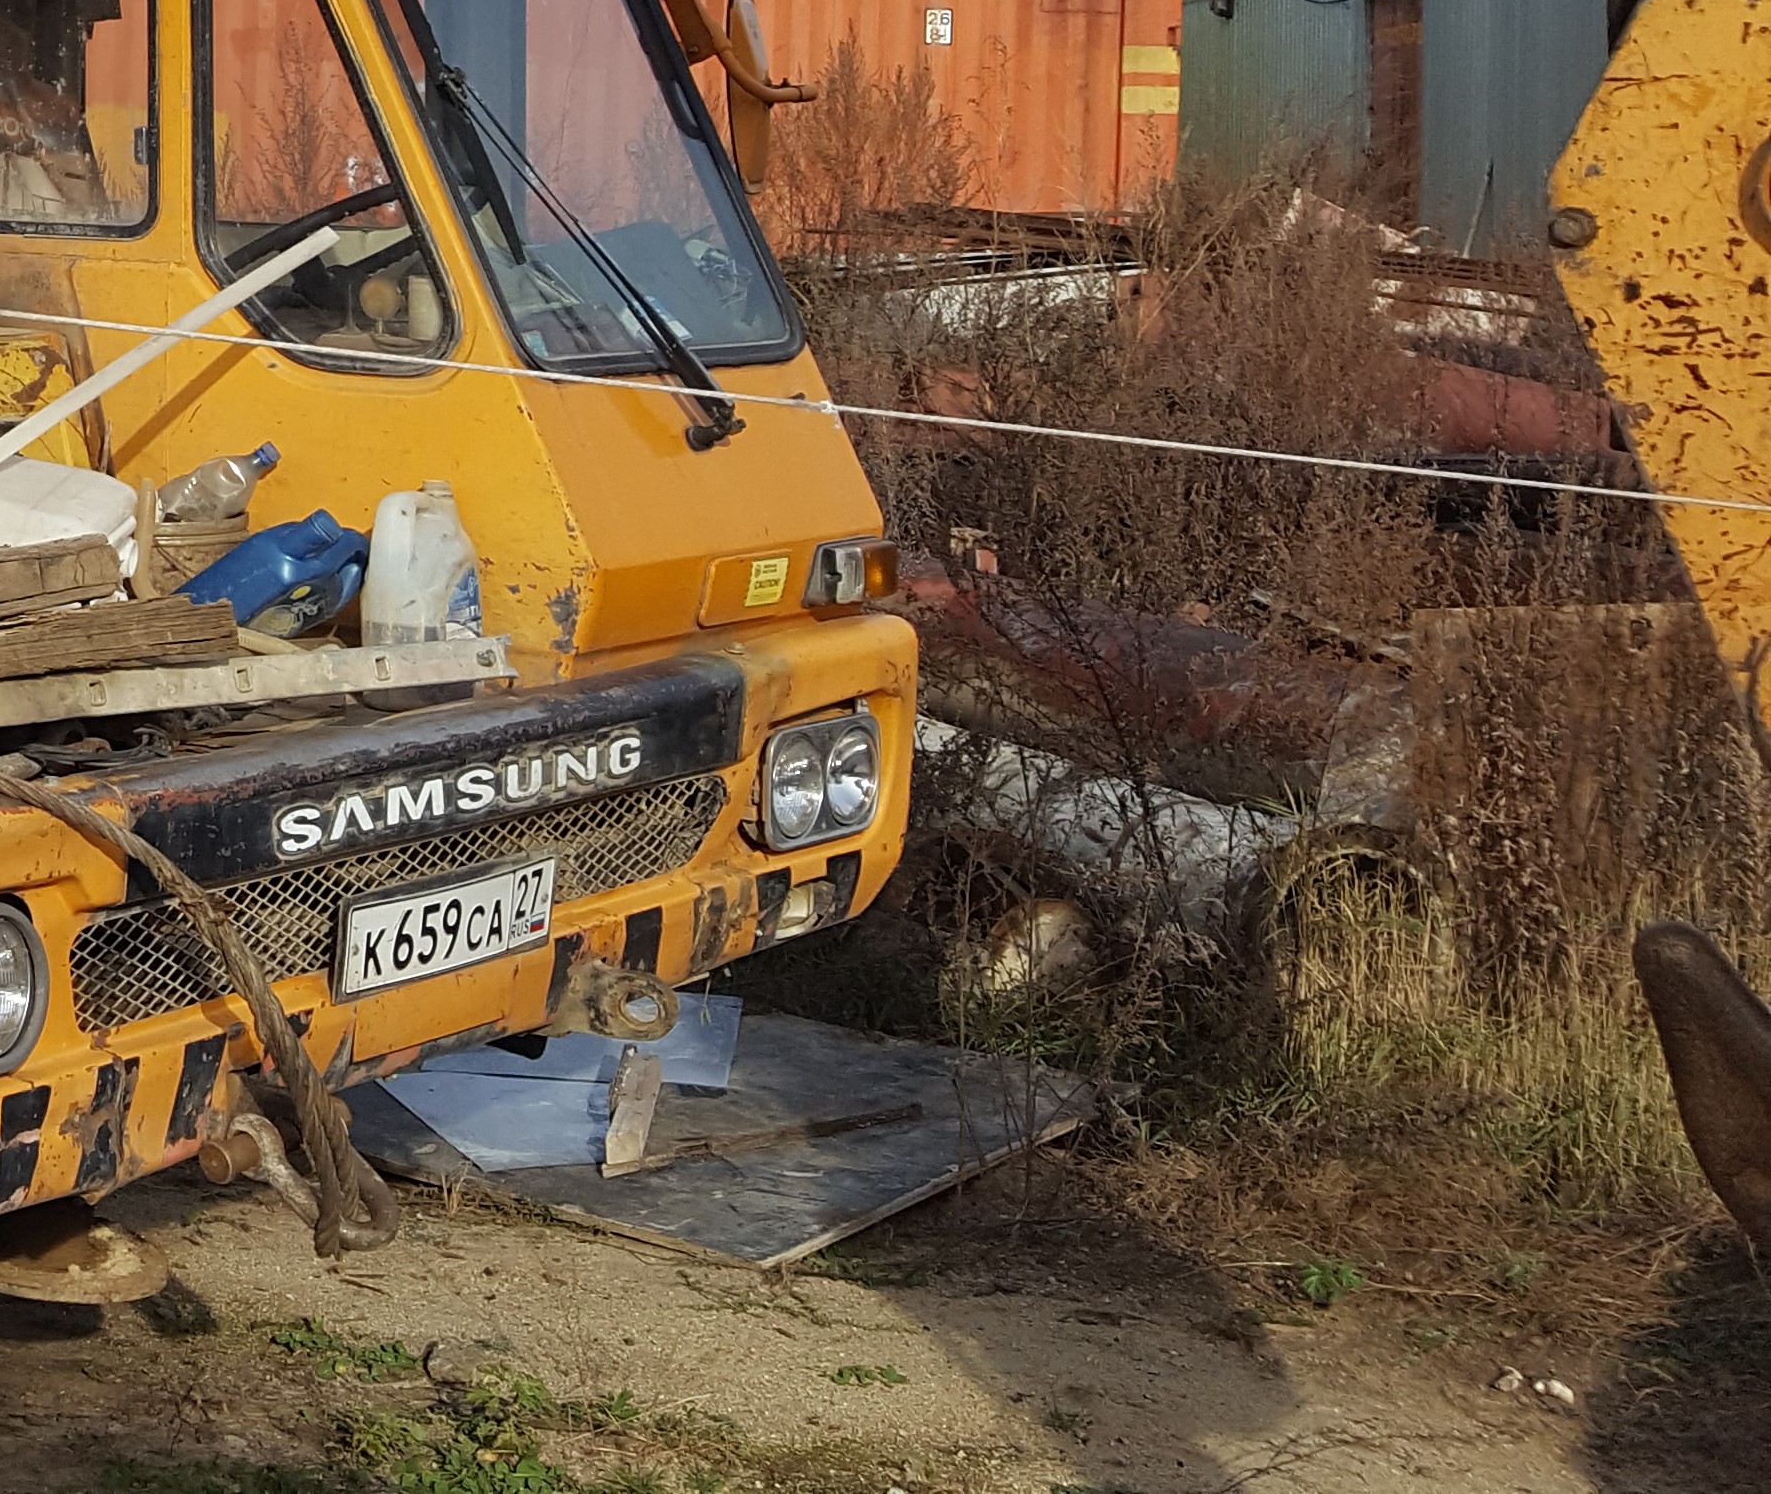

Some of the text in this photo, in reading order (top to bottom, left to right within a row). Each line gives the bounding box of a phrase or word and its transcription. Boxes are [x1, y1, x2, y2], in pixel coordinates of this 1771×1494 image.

[278, 736, 643, 853] SAMSUNG
[515, 867, 544, 921] 27
[510, 922, 530, 940] RUS
